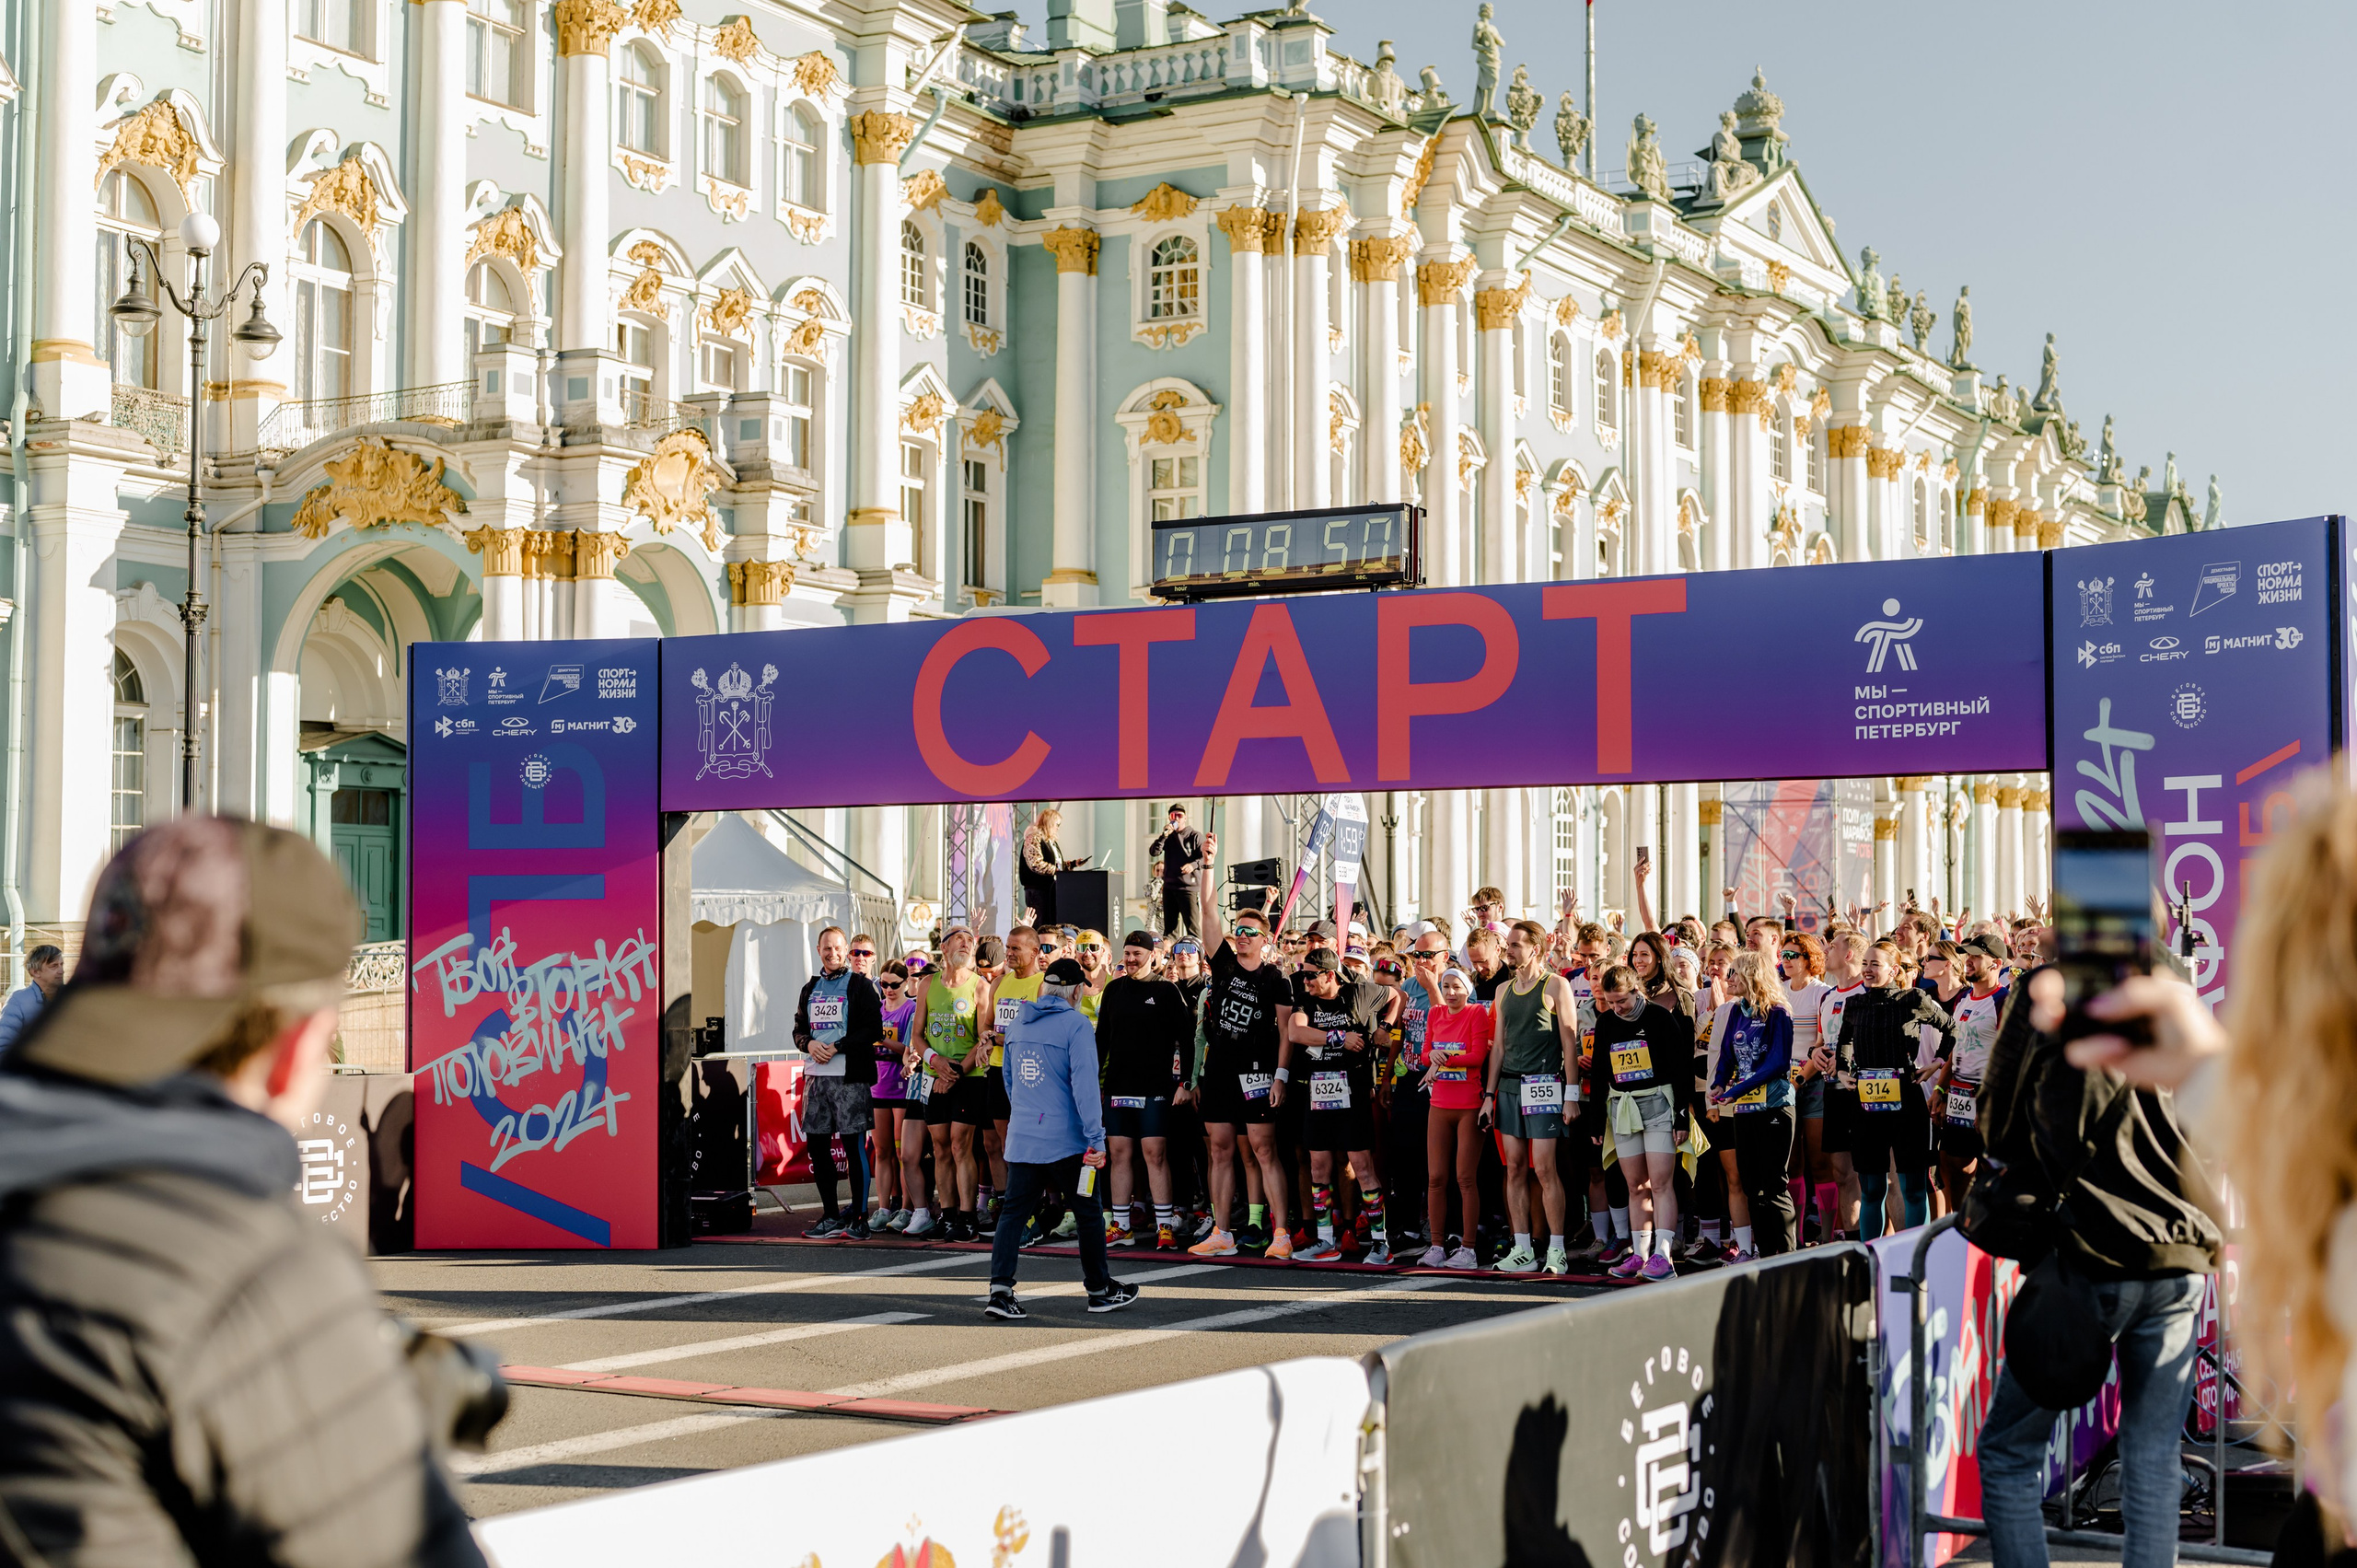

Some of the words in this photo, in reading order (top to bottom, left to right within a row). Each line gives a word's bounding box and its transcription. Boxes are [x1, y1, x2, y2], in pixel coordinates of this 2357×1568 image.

[2258, 562, 2293, 577] СПОРТ
[2258, 574, 2302, 591] НОРМА
[2258, 587, 2302, 605] ЖИЗНИ
[2134, 605, 2174, 615] СПОРТИВНЫЙ
[2134, 614, 2165, 622] ПЕТЕРБУРГ
[2223, 634, 2272, 649] МАГНИТ
[2099, 643, 2121, 655] сбп
[2140, 651, 2189, 662] CHERY
[598, 668, 630, 679] СПОРТ
[598, 679, 636, 689] НОРМА
[912, 578, 1687, 796] СТАРТ
[598, 689, 636, 699] ЖИЗНИ
[1855, 684, 1887, 700] МЫ
[1854, 696, 1990, 720] СПОРТИВНЫЙ
[455, 719, 475, 727] сбп
[567, 722, 610, 730] МАГНИТ
[1855, 721, 1961, 739] ПЕТЕРБУРГ
[814, 1005, 838, 1016] 3428
[1314, 1014, 1347, 1023] МАРАФОН
[1619, 1052, 1639, 1066] 731
[1315, 1082, 1342, 1095] 6324
[1530, 1086, 1553, 1098] 555
[1866, 1083, 1890, 1096] 314
[1949, 1097, 1972, 1111] 6366
[490, 1084, 631, 1173] 2024
[1620, 1345, 1713, 1444] БЕГОВОЕ
